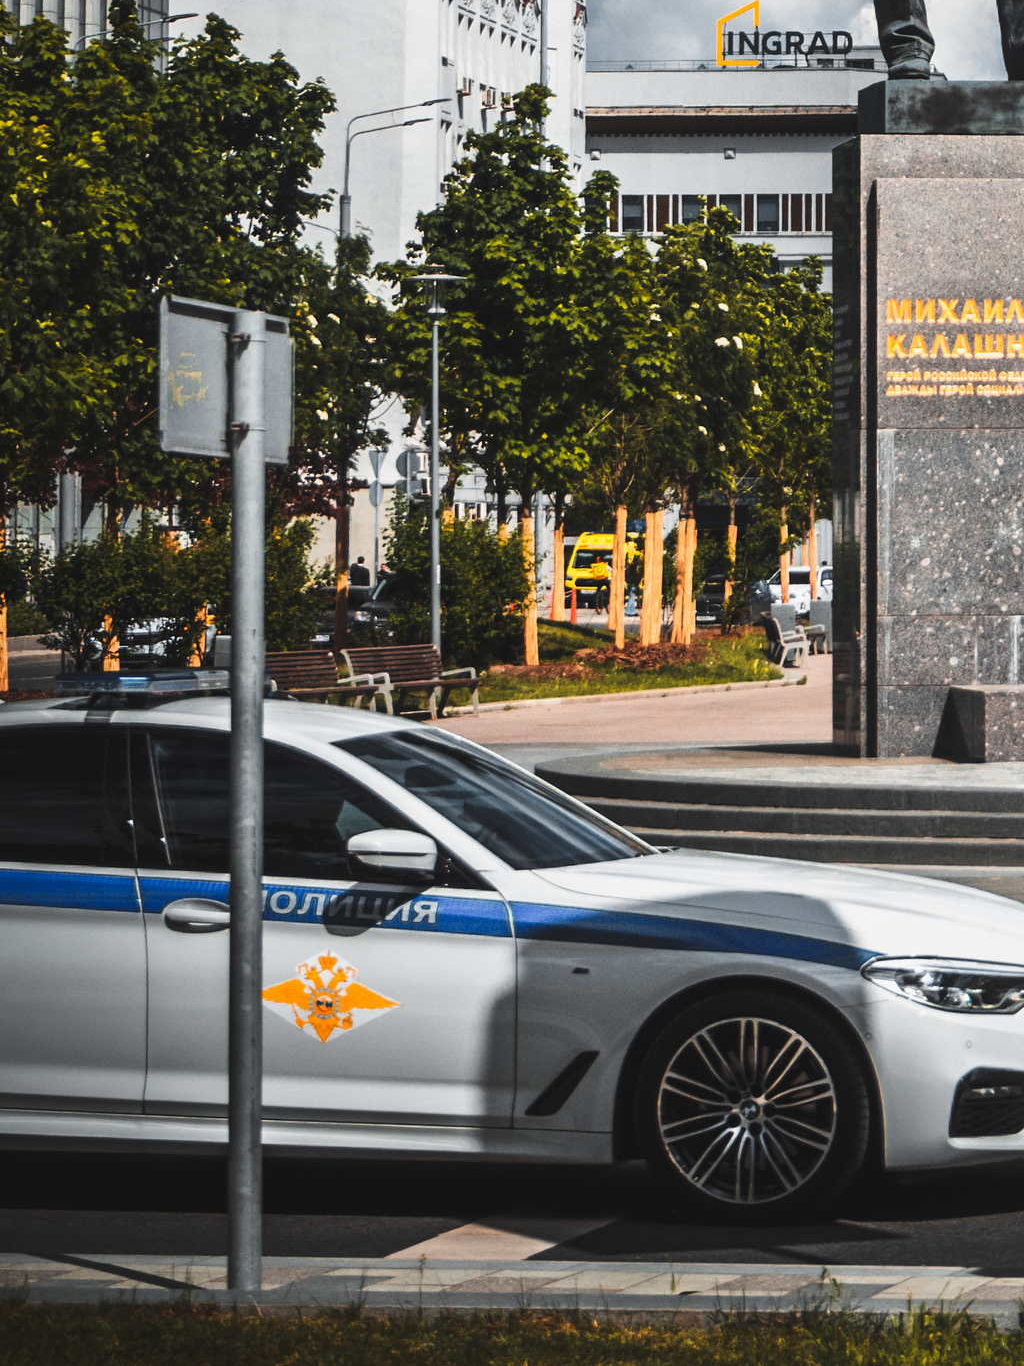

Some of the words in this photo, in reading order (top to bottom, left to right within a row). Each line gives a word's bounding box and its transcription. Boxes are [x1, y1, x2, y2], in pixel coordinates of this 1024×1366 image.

[728, 30, 853, 56] INGRAD
[886, 368, 922, 382] ГЕРОЙ
[923, 368, 997, 382] РОССИЙСКОЙ
[885, 384, 938, 397] ДВАЖДЫ
[939, 382, 974, 396] ГЕРОЙ
